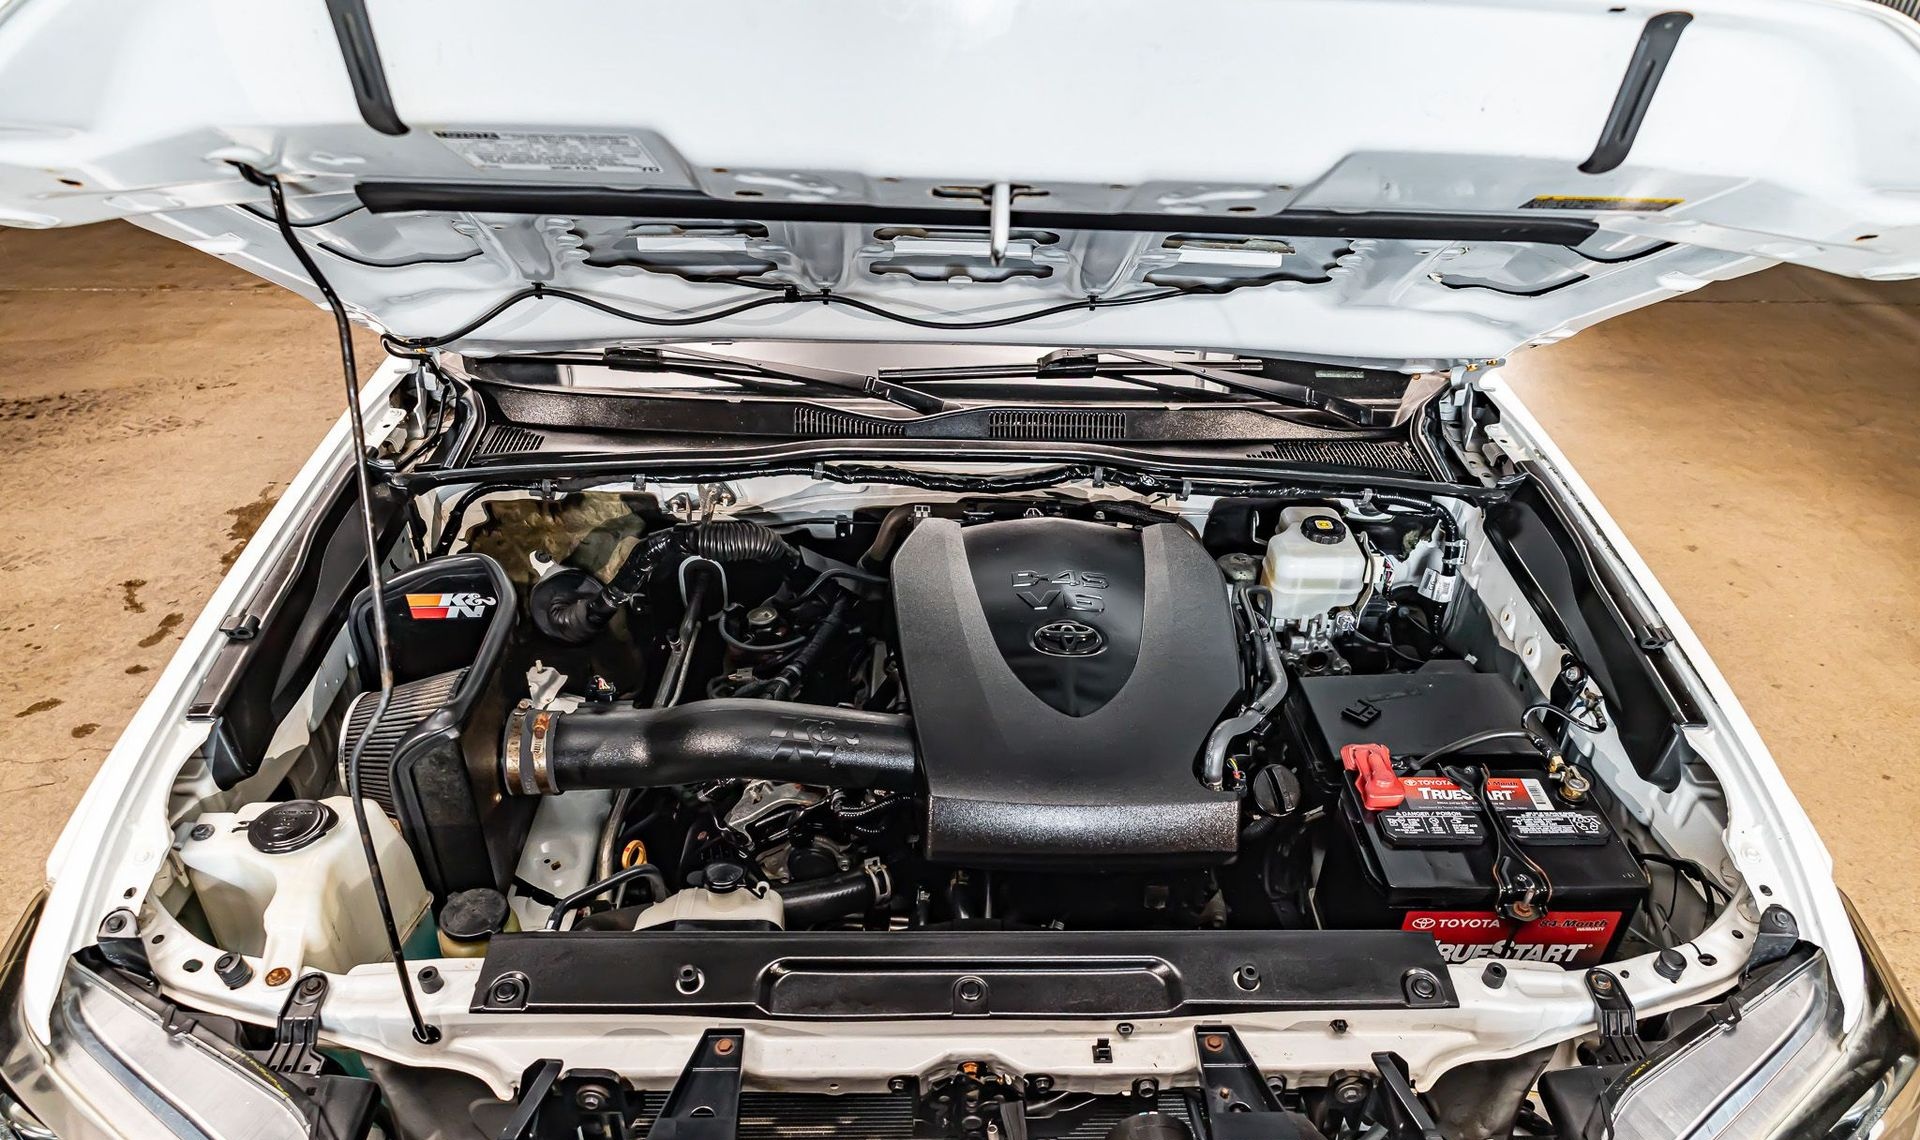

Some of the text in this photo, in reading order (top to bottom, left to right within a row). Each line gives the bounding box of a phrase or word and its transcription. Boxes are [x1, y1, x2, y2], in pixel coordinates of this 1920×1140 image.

[1011, 570, 1110, 589] D-4S
[438, 592, 497, 619] K&N
[1016, 589, 1106, 613] V6
[1439, 919, 1501, 929] TOYOTA
[1435, 939, 1588, 963] RUESTART
